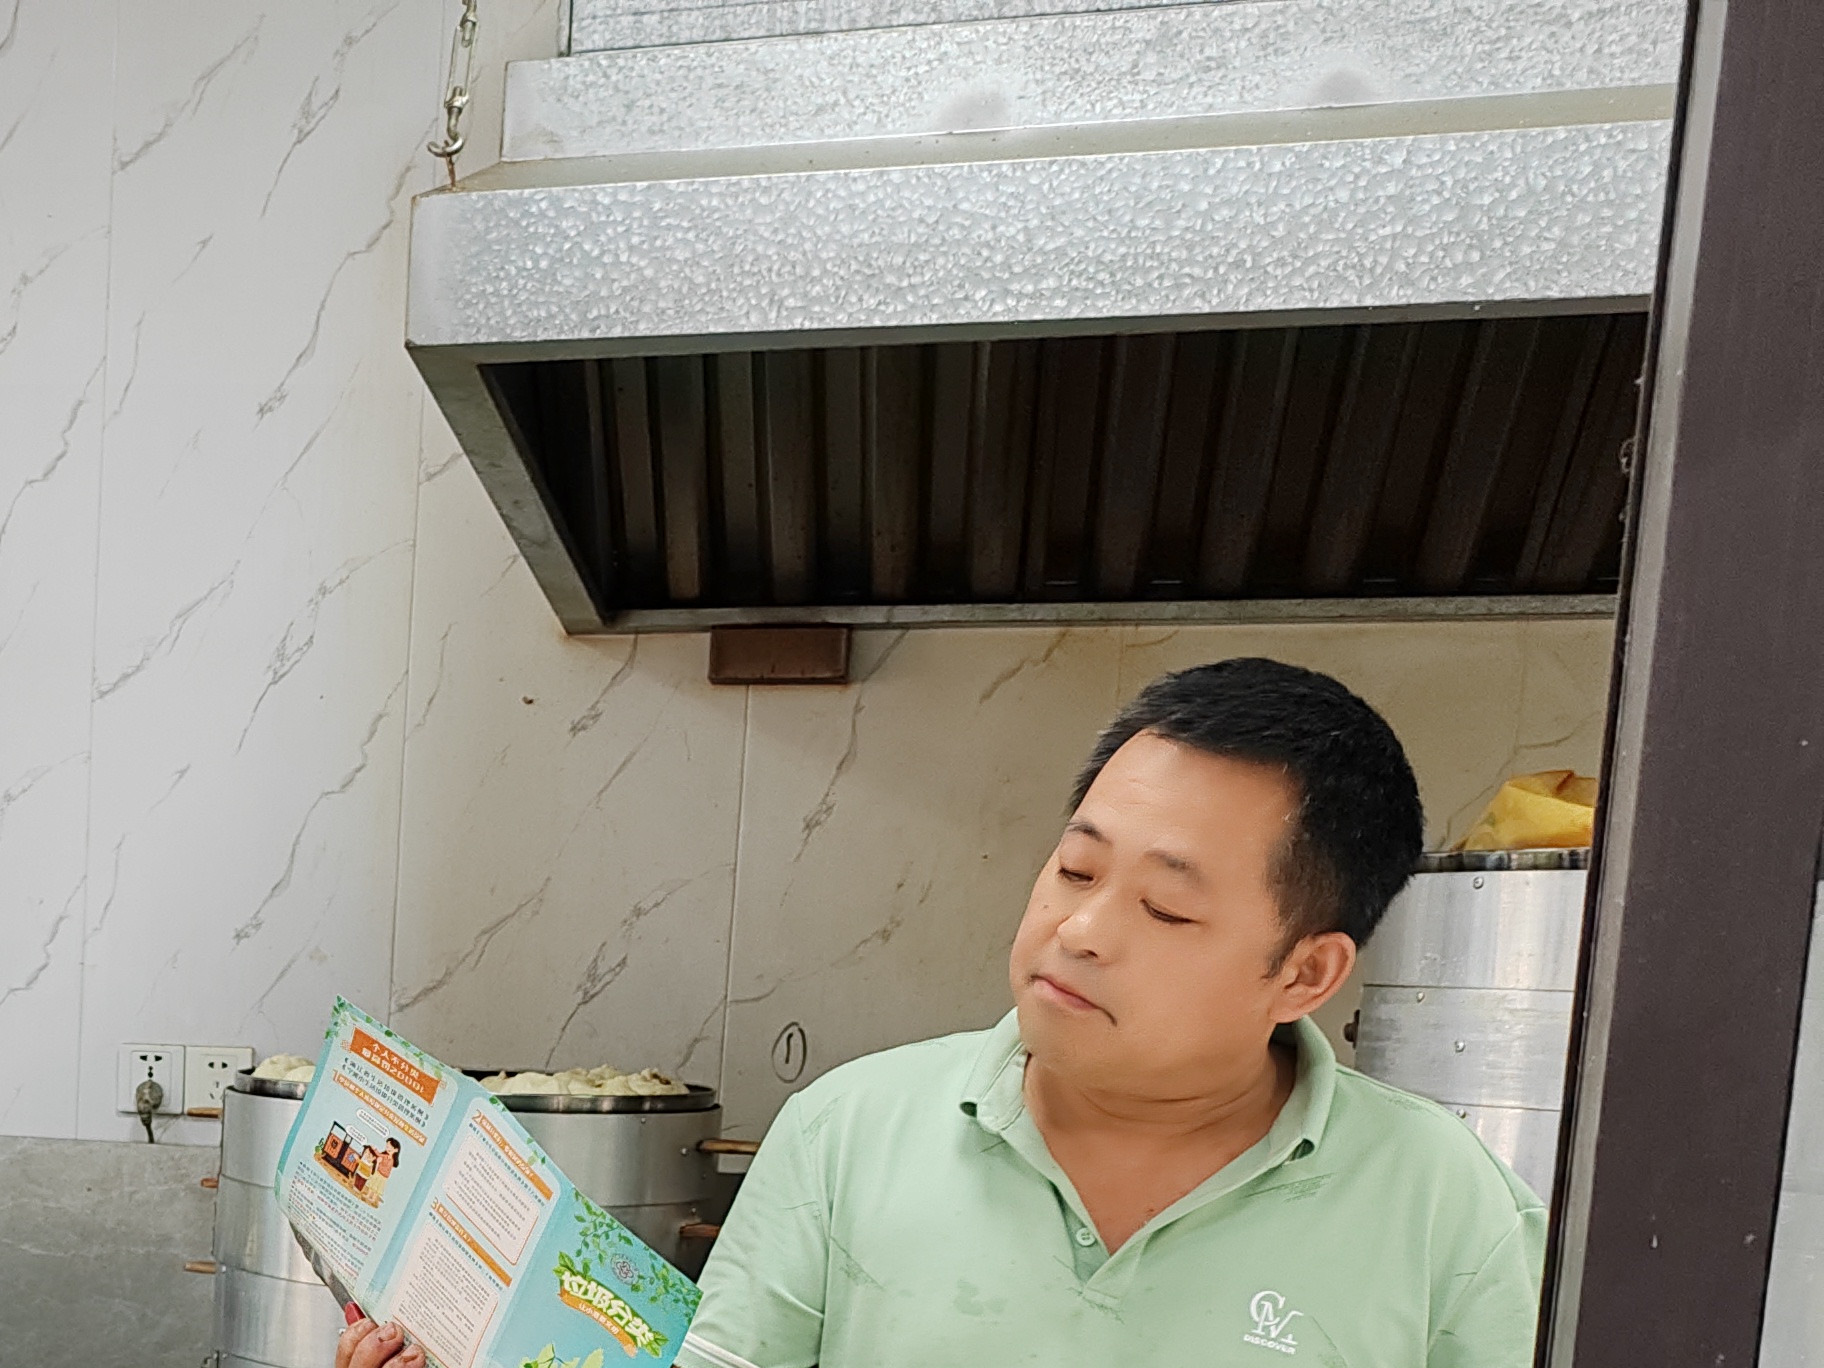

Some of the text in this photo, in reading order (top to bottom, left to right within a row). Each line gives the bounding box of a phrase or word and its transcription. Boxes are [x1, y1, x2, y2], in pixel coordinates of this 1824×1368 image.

[561, 1271, 655, 1347] 垃圾分类
[1243, 1333, 1296, 1354] DISCOVER
